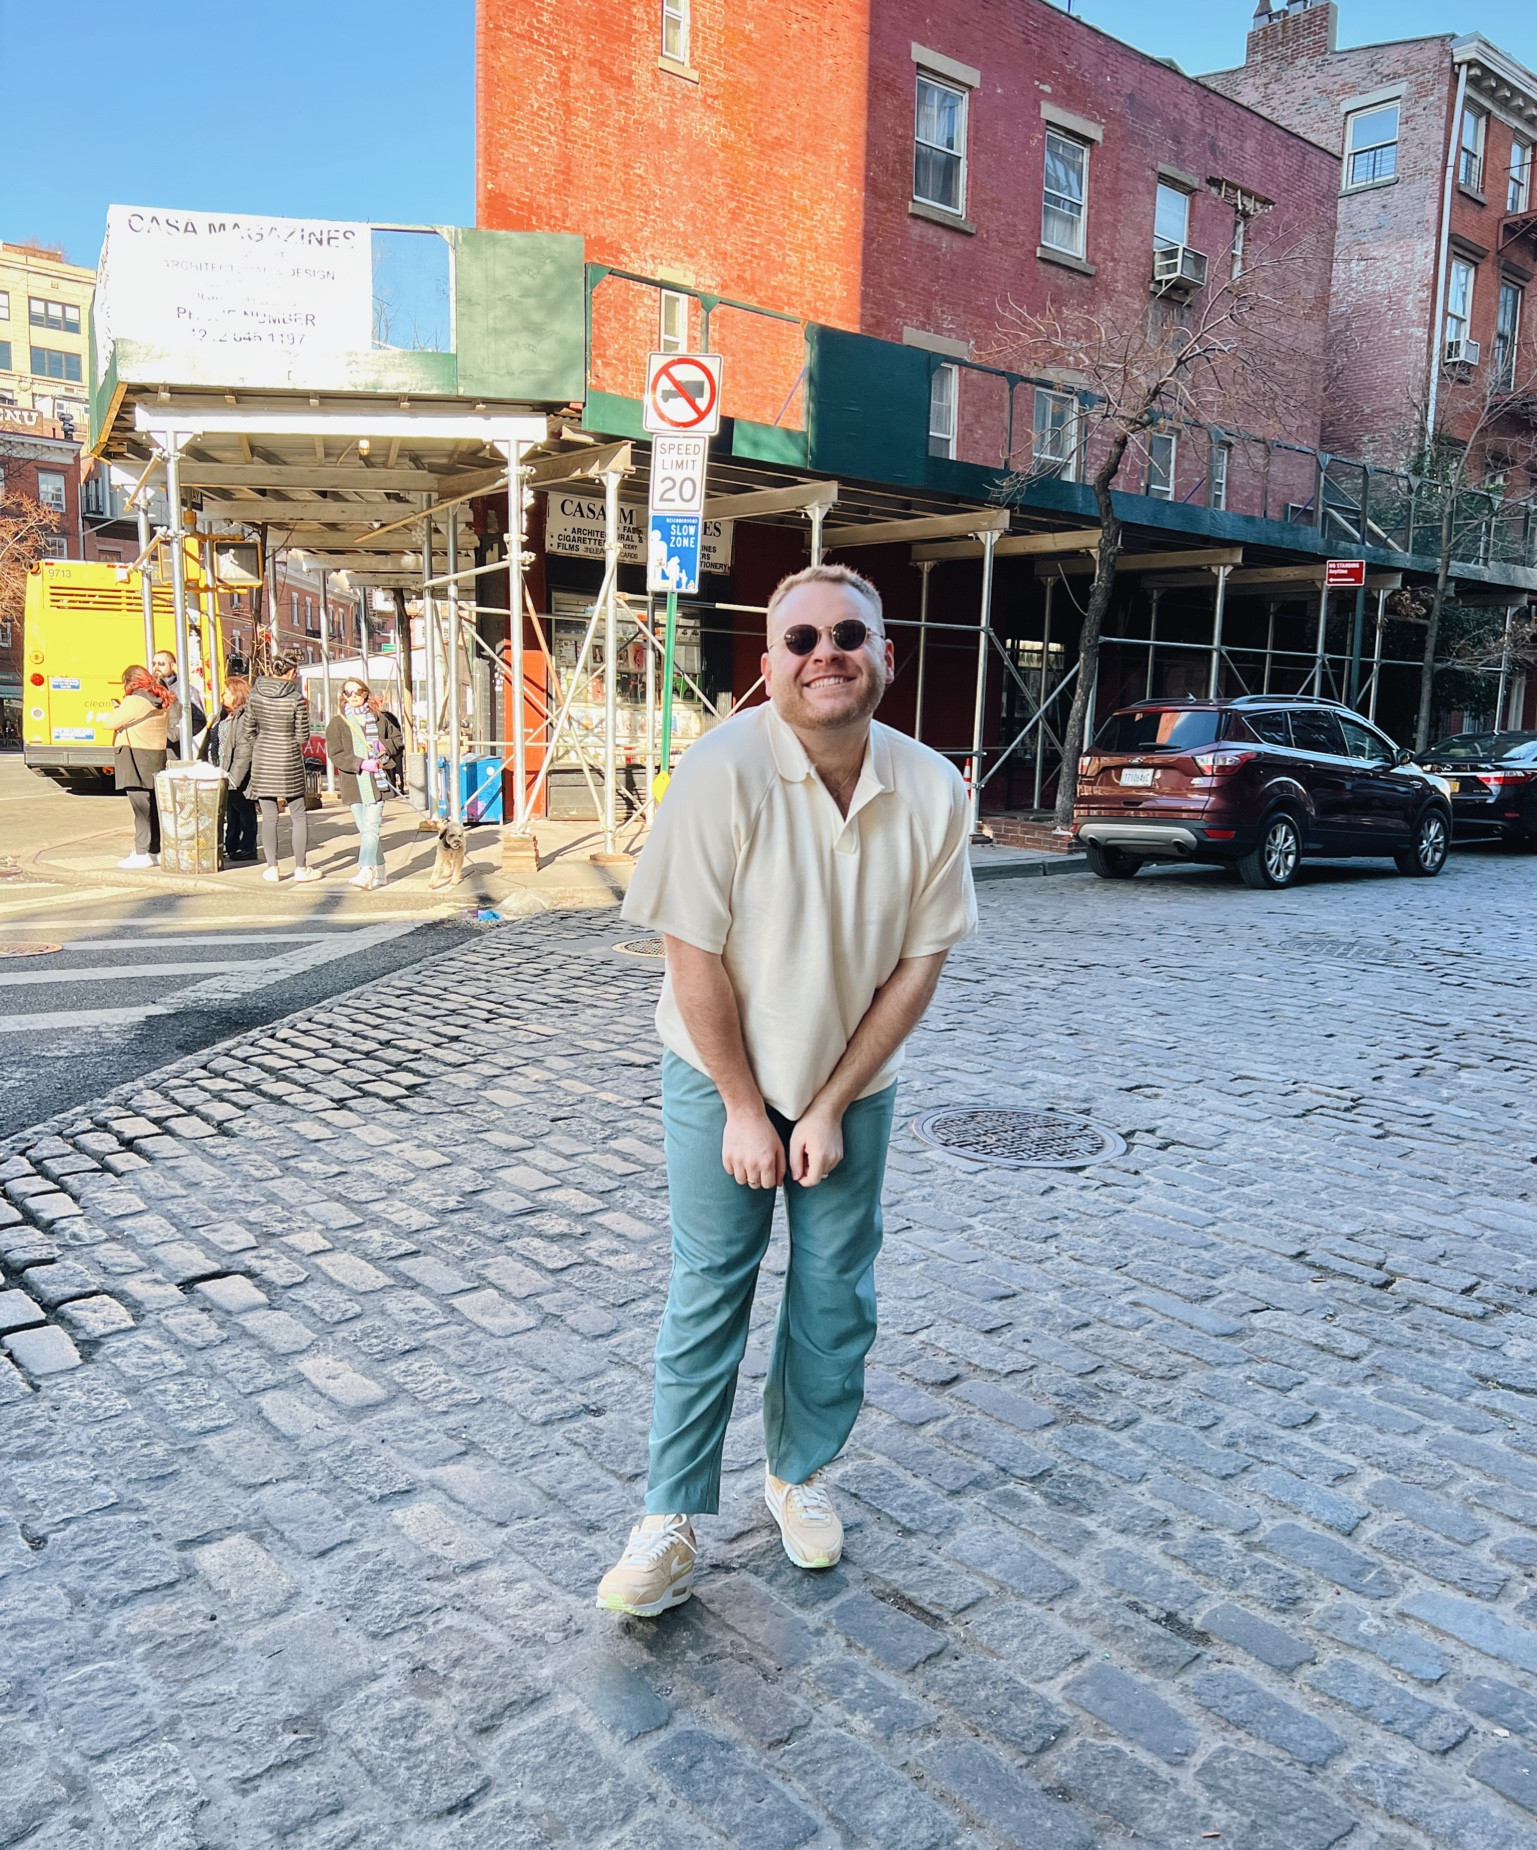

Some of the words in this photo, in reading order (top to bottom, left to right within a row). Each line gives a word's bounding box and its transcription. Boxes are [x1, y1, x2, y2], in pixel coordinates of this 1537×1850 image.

[128, 213, 198, 236] CASA
[660, 443, 701, 456] SPEED
[662, 459, 697, 471] LIMIT
[658, 476, 697, 503] 20
[561, 499, 606, 521] CASA
[670, 524, 696, 536] SLOW
[557, 543, 580, 552] FILMS
[670, 536, 696, 548] ZONE
[48, 569, 72, 578] 9713
